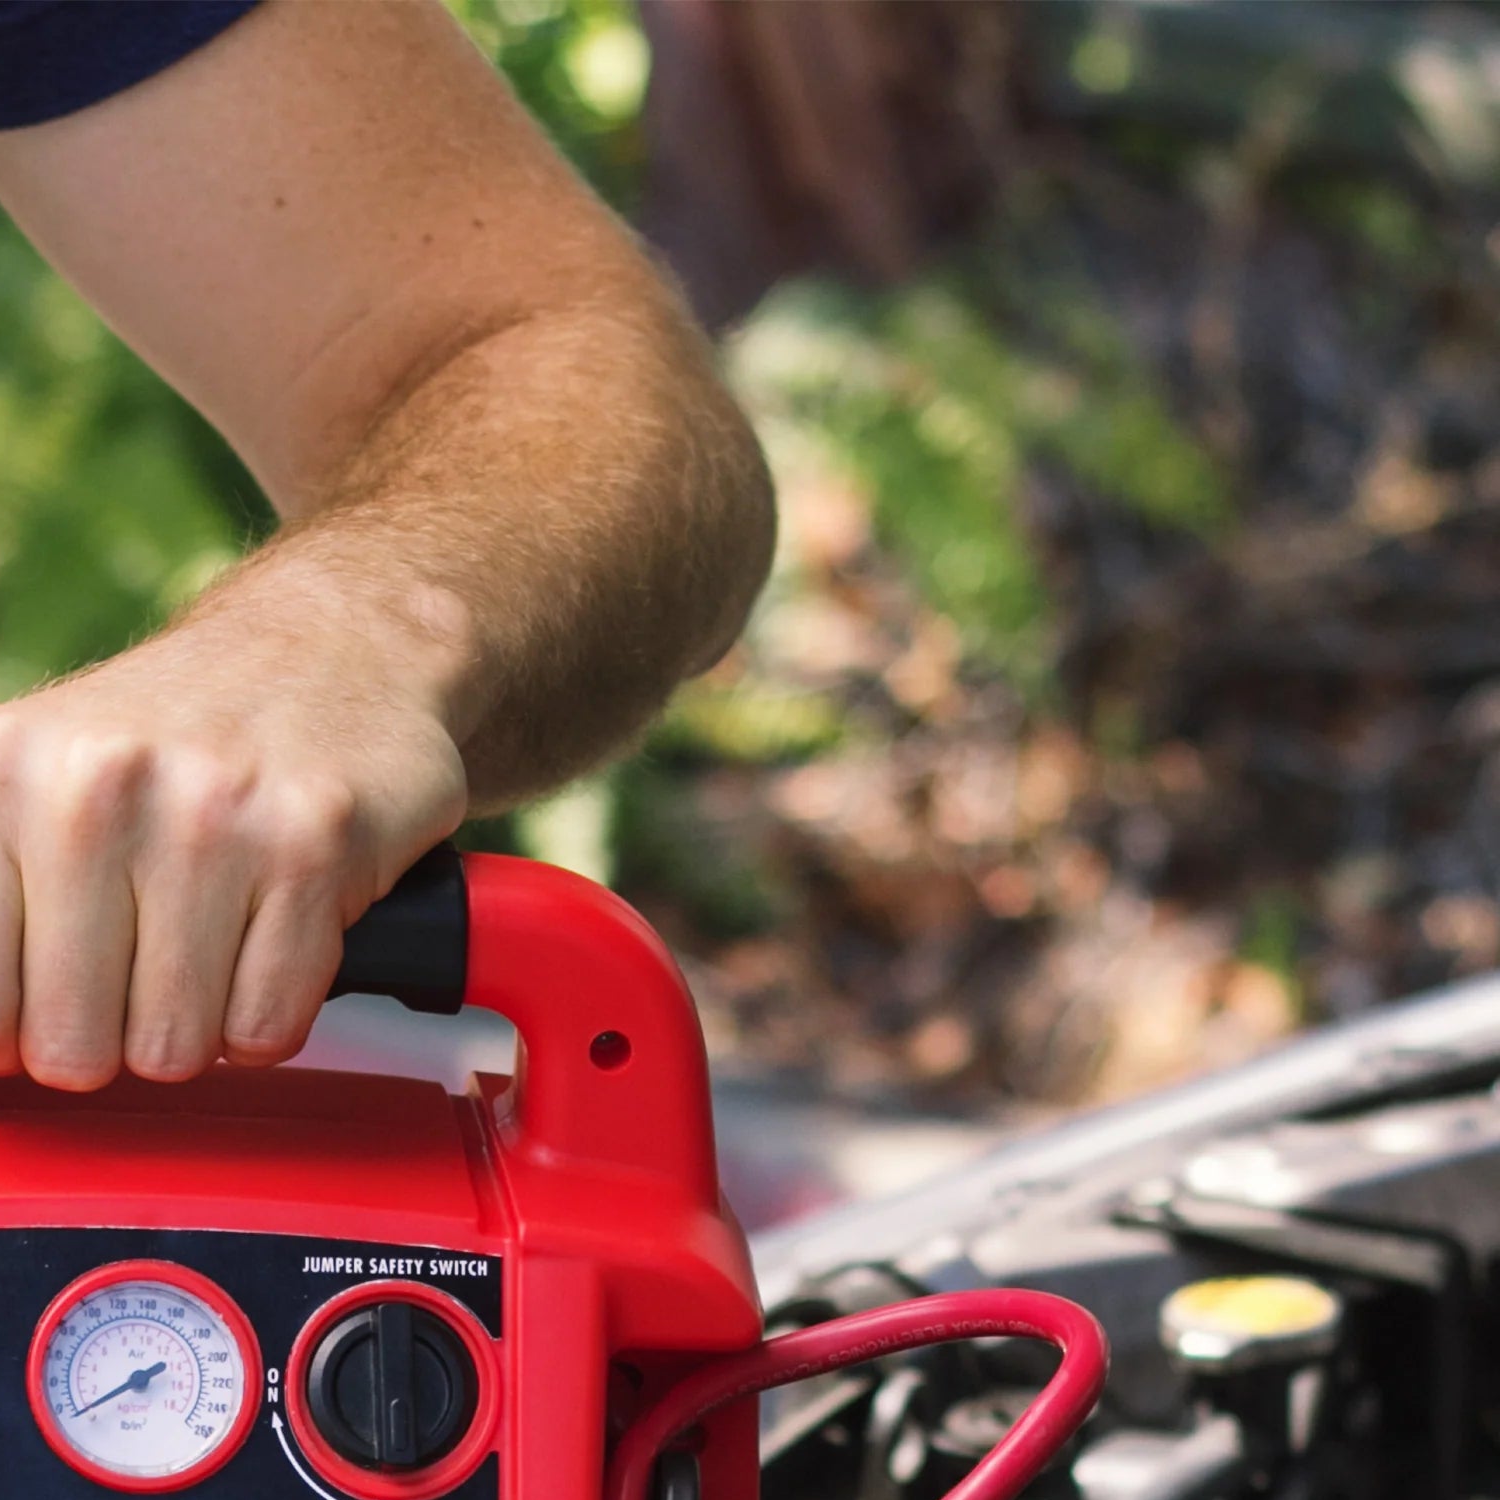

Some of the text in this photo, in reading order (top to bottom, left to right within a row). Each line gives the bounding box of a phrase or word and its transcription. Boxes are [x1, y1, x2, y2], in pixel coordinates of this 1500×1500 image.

[301, 1256, 488, 1277] JUMPER SAFETY SWITCH
[109, 1299, 127, 1310] 120
[139, 1299, 157, 1310] 140
[167, 1307, 185, 1318] 160
[193, 1327, 211, 1339] 180
[828, 1322, 947, 1364] ELECTRONICS
[127, 1348, 145, 1359] Air
[207, 1351, 228, 1363] 200
[267, 1367, 278, 1403] ON
